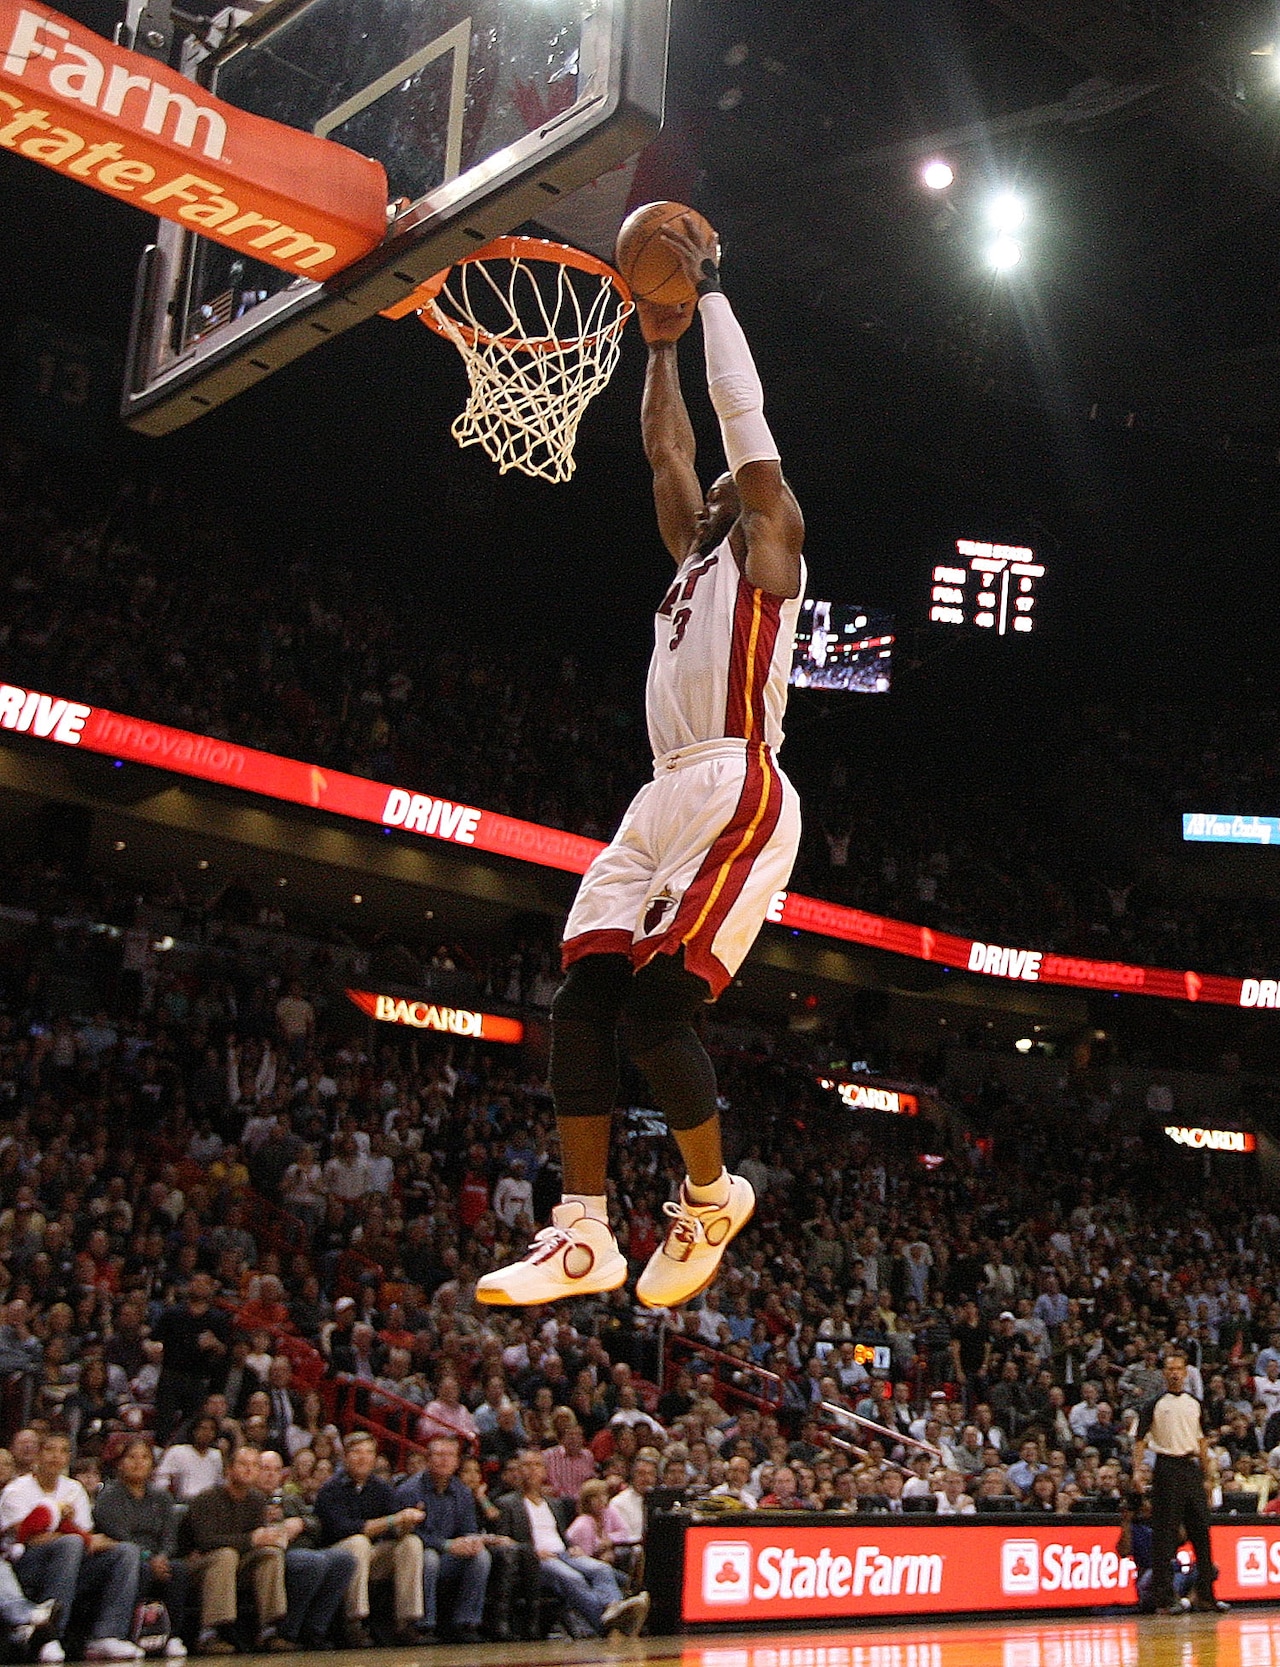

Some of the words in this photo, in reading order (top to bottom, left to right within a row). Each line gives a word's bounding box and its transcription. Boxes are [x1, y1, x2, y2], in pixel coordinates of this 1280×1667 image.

[3, 9, 228, 161] Farm
[142, 173, 338, 269] Farm
[669, 607, 693, 651] 3
[0, 684, 92, 745] RIVE
[382, 788, 482, 844] DRIVE
[967, 942, 1043, 981] DRIVE
[375, 995, 483, 1038] BACARDI
